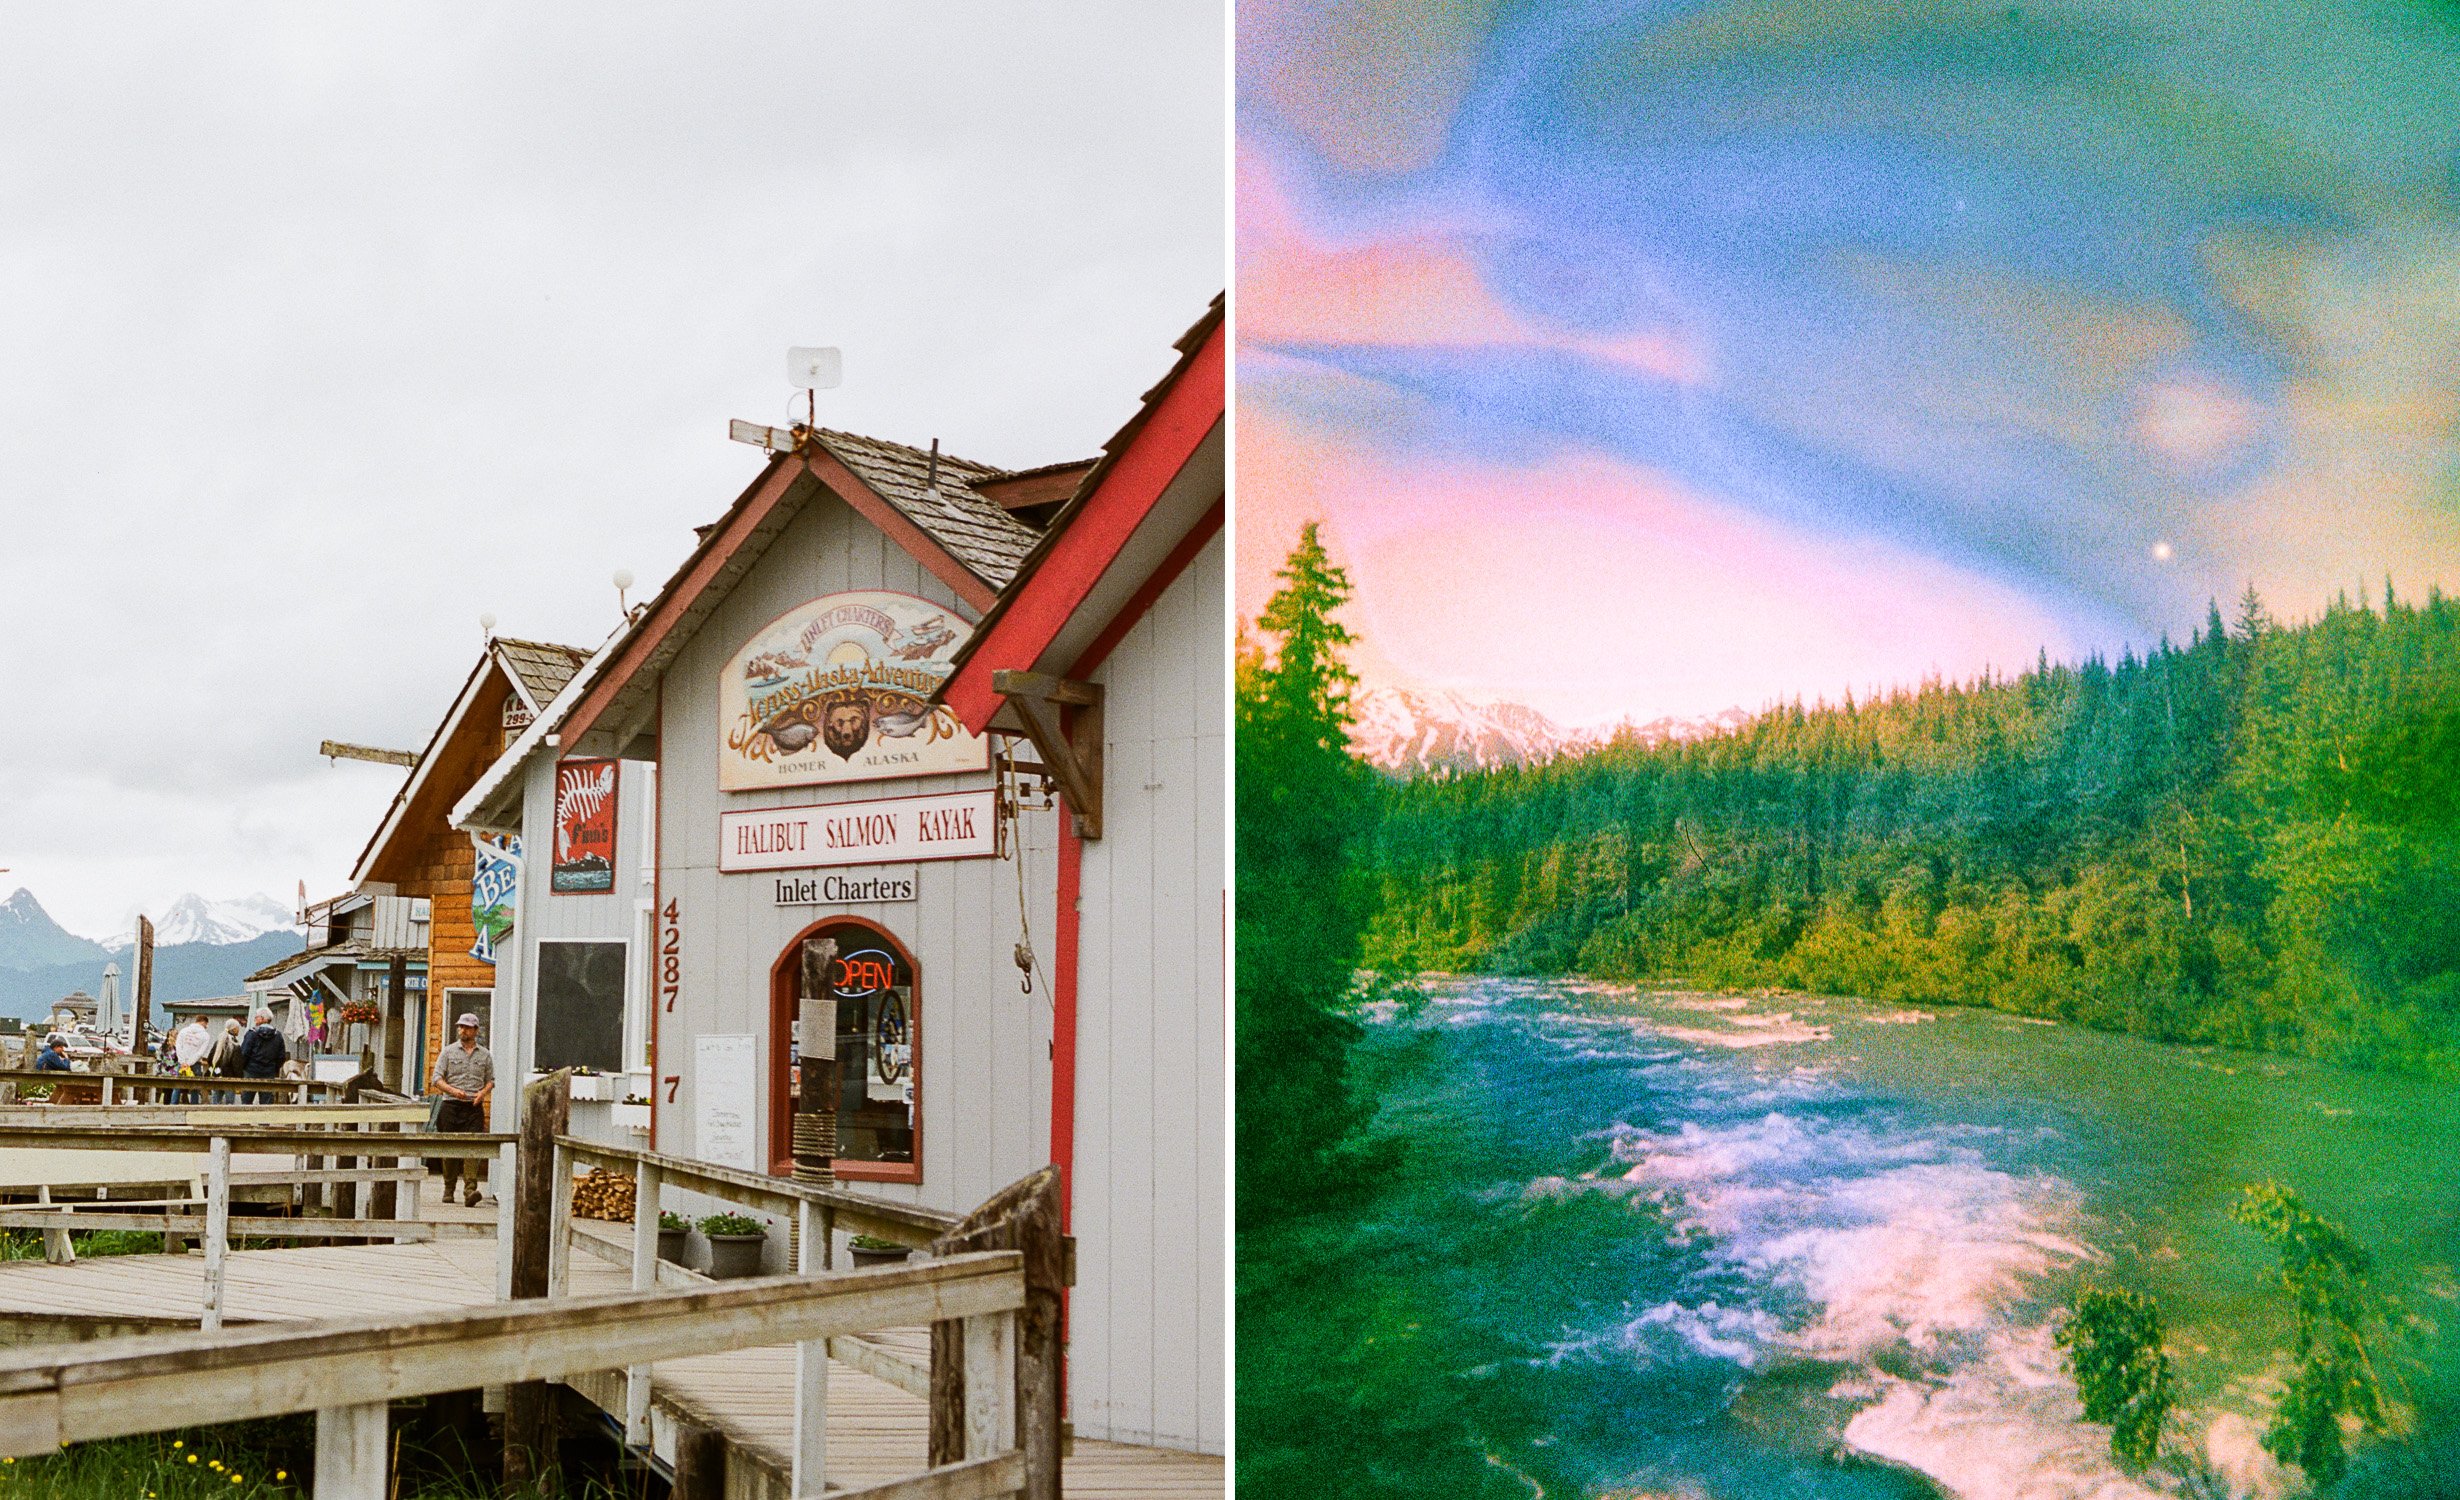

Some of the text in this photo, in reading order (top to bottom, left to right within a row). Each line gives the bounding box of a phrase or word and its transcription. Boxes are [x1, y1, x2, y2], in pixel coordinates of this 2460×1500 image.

[836, 606, 891, 634] CHARTERS
[778, 752, 920, 775] HOMER ALASKA
[737, 807, 977, 855] HALIBUT SALMON KAYAK
[775, 875, 912, 903] Inlet Charters
[663, 897, 680, 1013] 4287
[664, 1075, 681, 1104] 7
